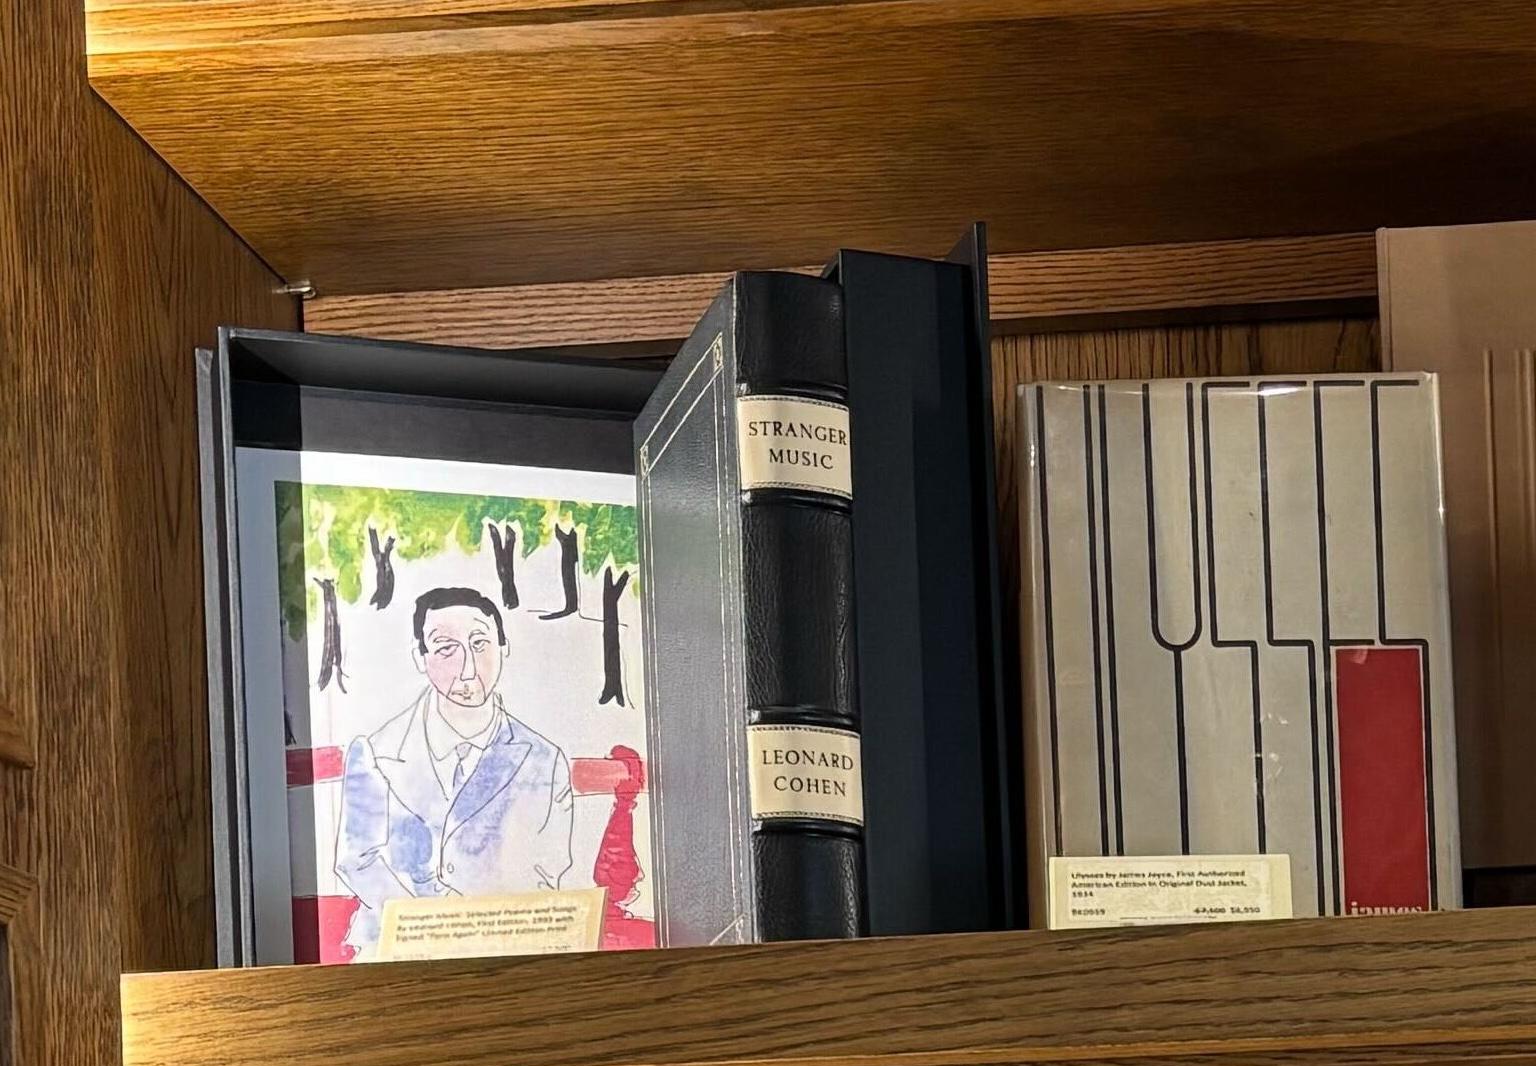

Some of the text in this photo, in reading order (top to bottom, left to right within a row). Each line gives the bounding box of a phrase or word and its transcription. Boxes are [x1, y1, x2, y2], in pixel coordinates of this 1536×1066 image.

[748, 421, 847, 445] STRANGER
[769, 448, 833, 469] MUSIC
[762, 750, 853, 770] LEONARD
[774, 776, 846, 796] COHEN
